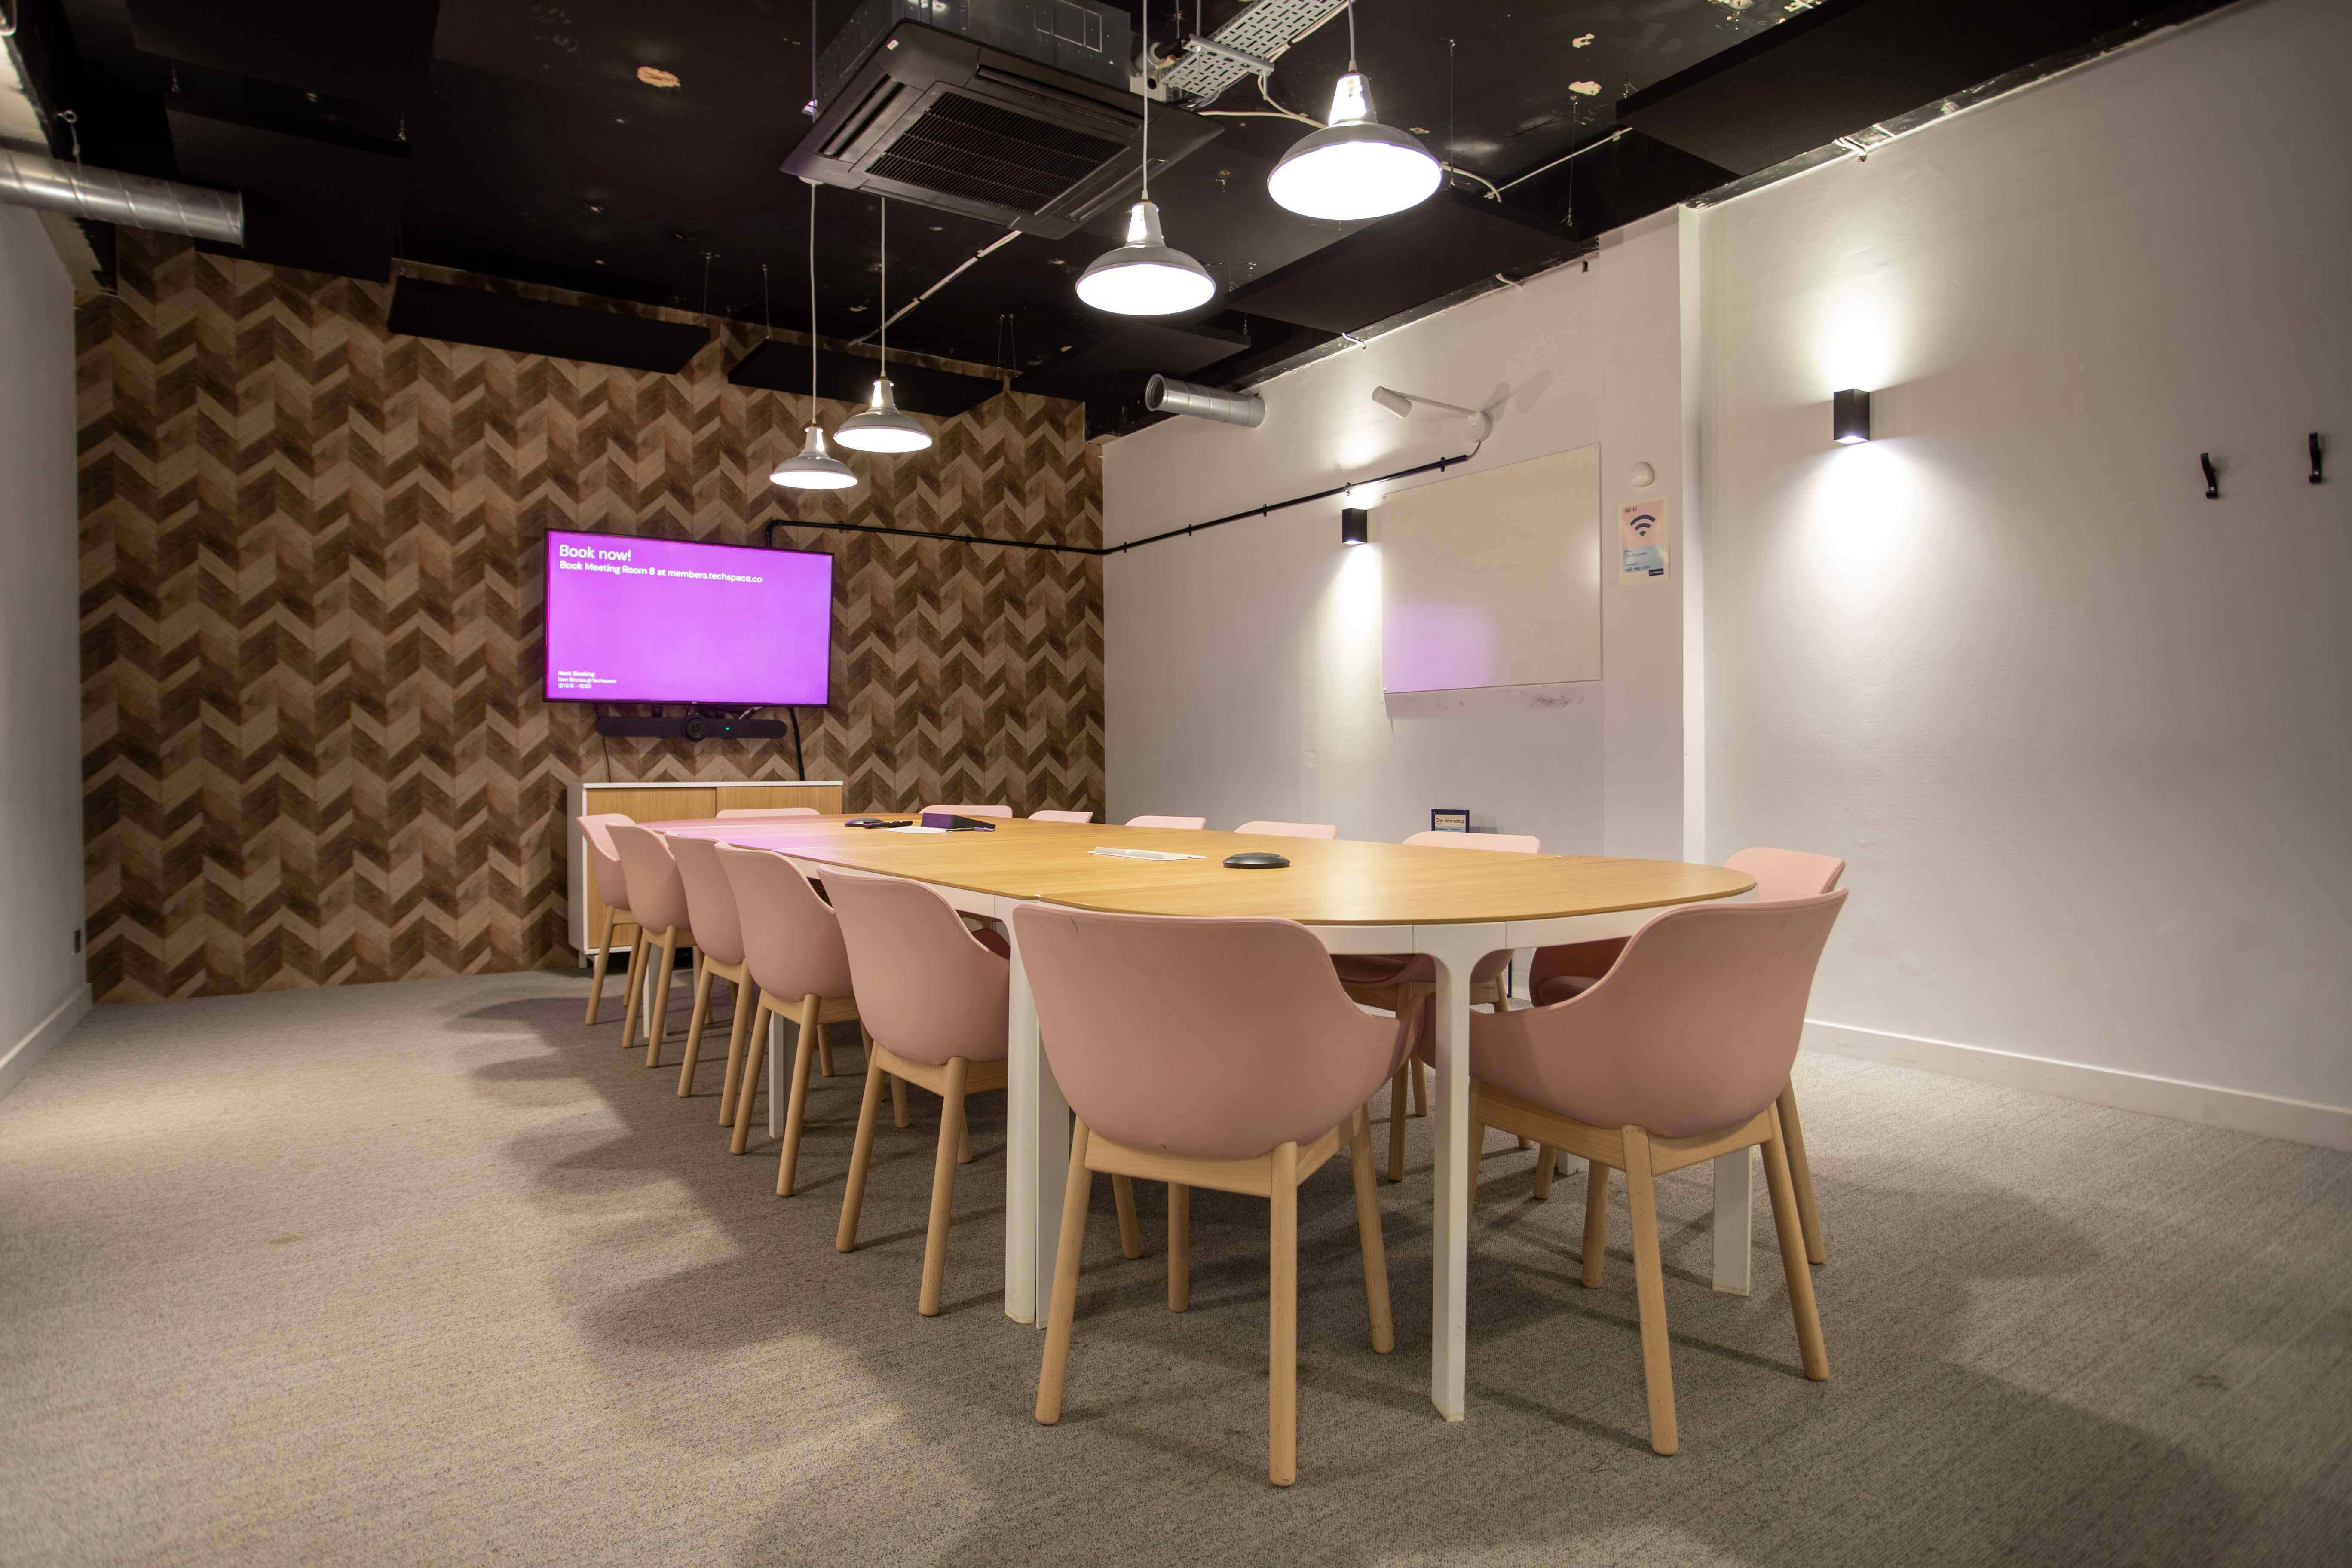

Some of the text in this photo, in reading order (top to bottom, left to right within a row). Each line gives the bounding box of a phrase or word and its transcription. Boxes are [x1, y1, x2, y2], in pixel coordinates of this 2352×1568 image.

[559, 544, 631, 561] Book now!
[560, 560, 582, 570] Book
[584, 562, 620, 575] Meeting
[622, 565, 647, 575] Room
[649, 567, 655, 575] 8
[668, 570, 763, 583] members.techspace.co
